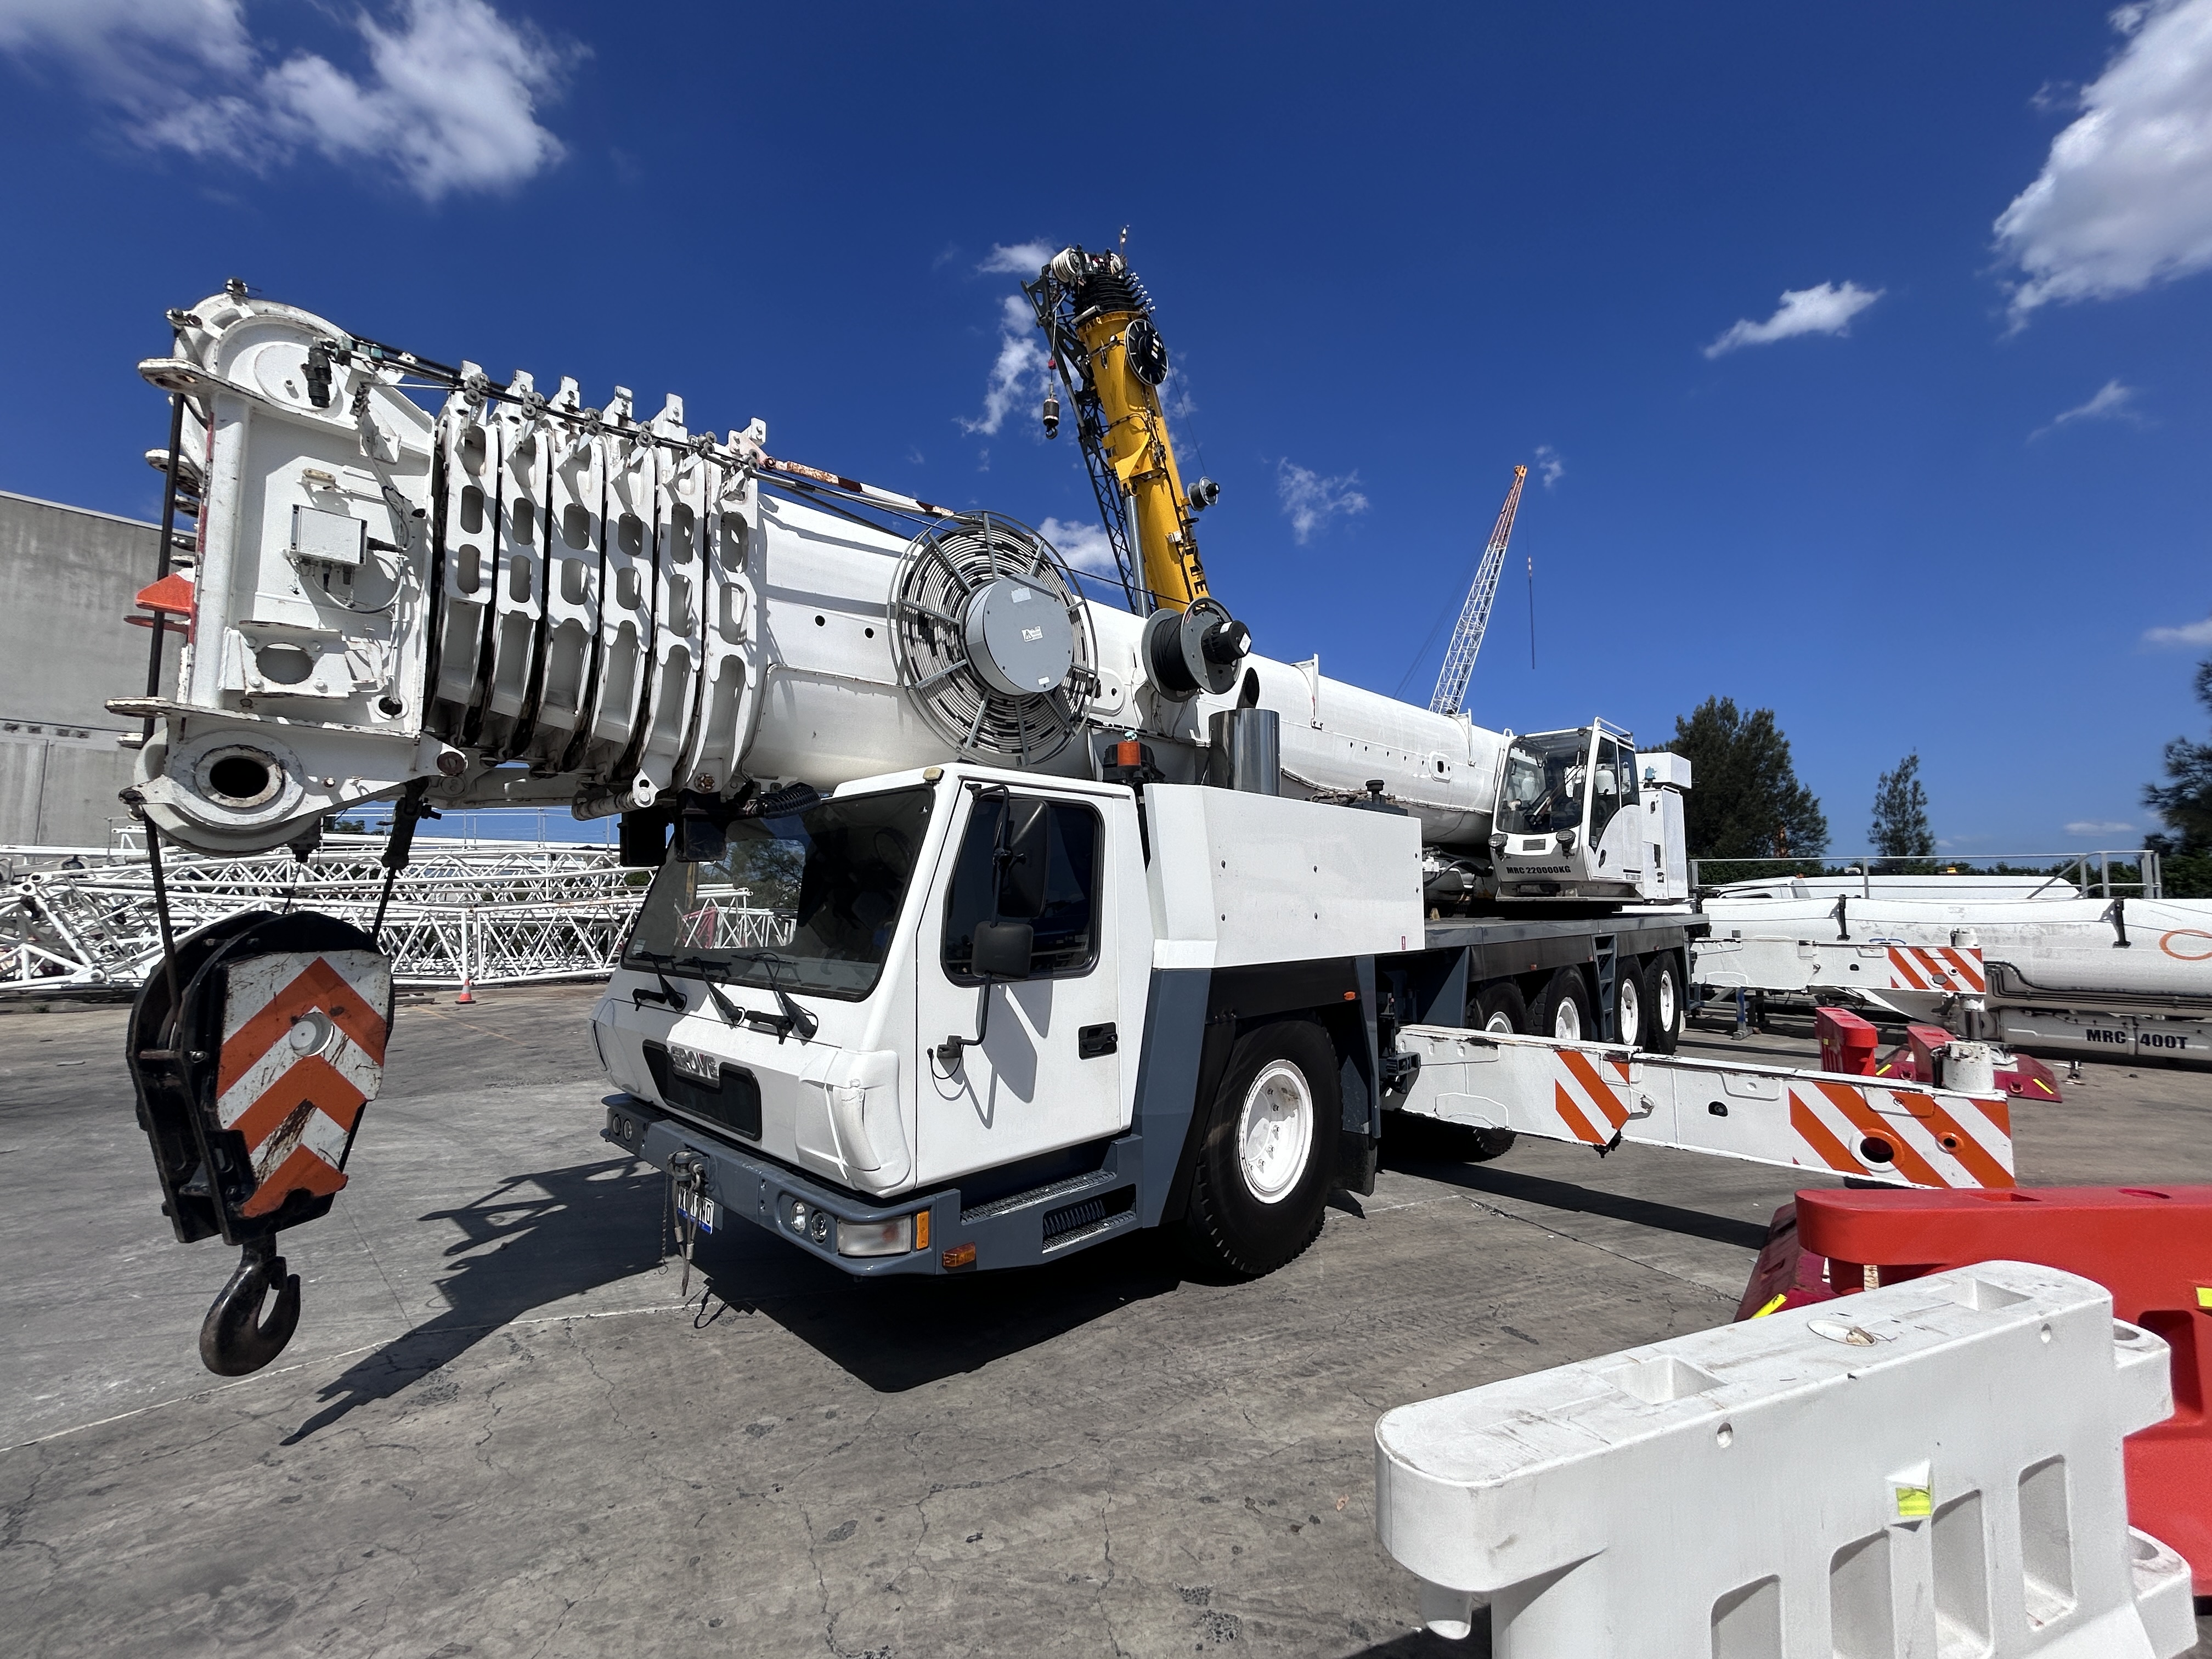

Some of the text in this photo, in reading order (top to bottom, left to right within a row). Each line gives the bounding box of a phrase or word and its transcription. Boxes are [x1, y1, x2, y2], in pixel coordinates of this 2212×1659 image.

[1526, 865, 1571, 874] 220000KG
[2086, 1029, 2188, 1049] MRC 400T
[670, 1046, 719, 1079] GROVE
